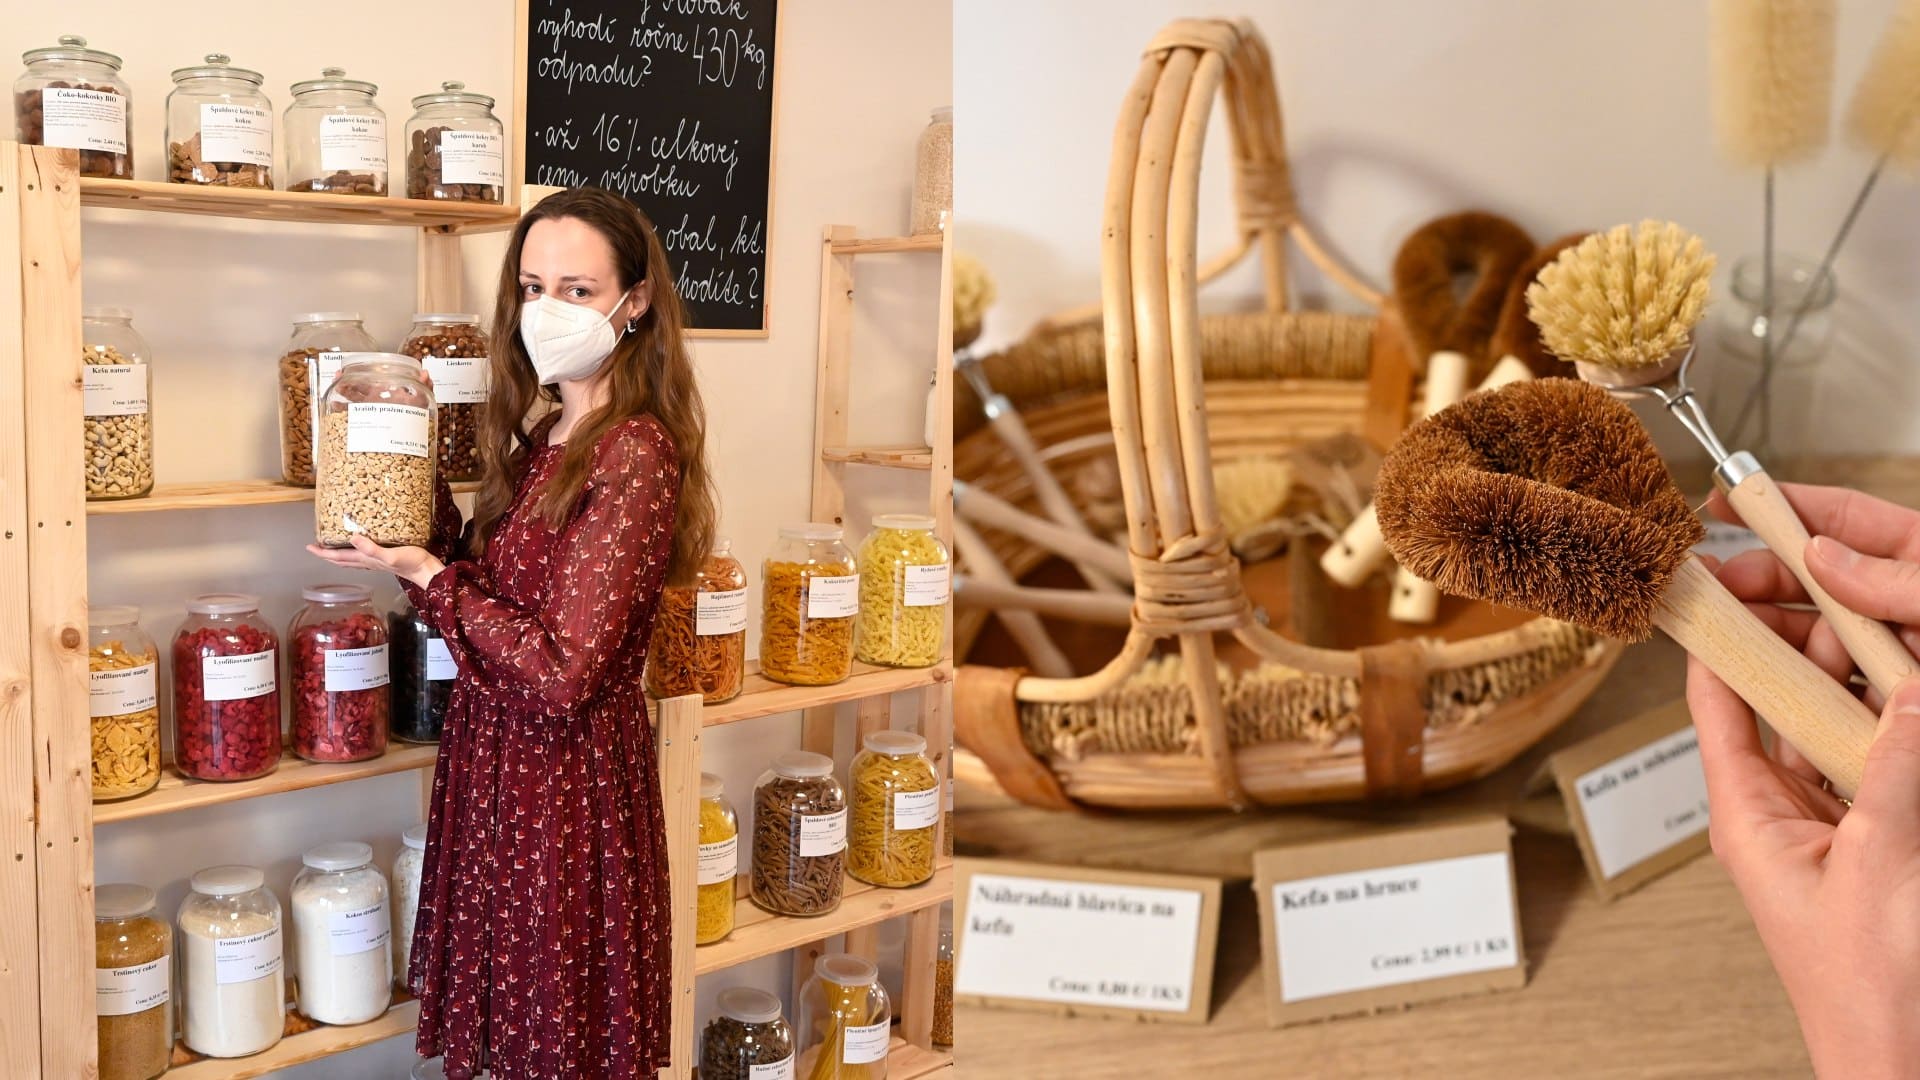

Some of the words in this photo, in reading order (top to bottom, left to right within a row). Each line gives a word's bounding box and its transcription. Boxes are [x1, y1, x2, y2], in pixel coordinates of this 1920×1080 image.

[537, 8, 617, 54] vyhodí
[629, 22, 689, 53] ročne
[693, 24, 739, 87] 430
[741, 28, 766, 90] kg
[538, 49, 652, 95] odpadu?
[545, 118, 579, 150] až
[666, 214, 724, 261] obal,
[1150, 903, 1176, 917] na
[1281, 886, 1330, 911] Kefa
[1334, 885, 1359, 904] na
[1363, 877, 1421, 899] hrnce
